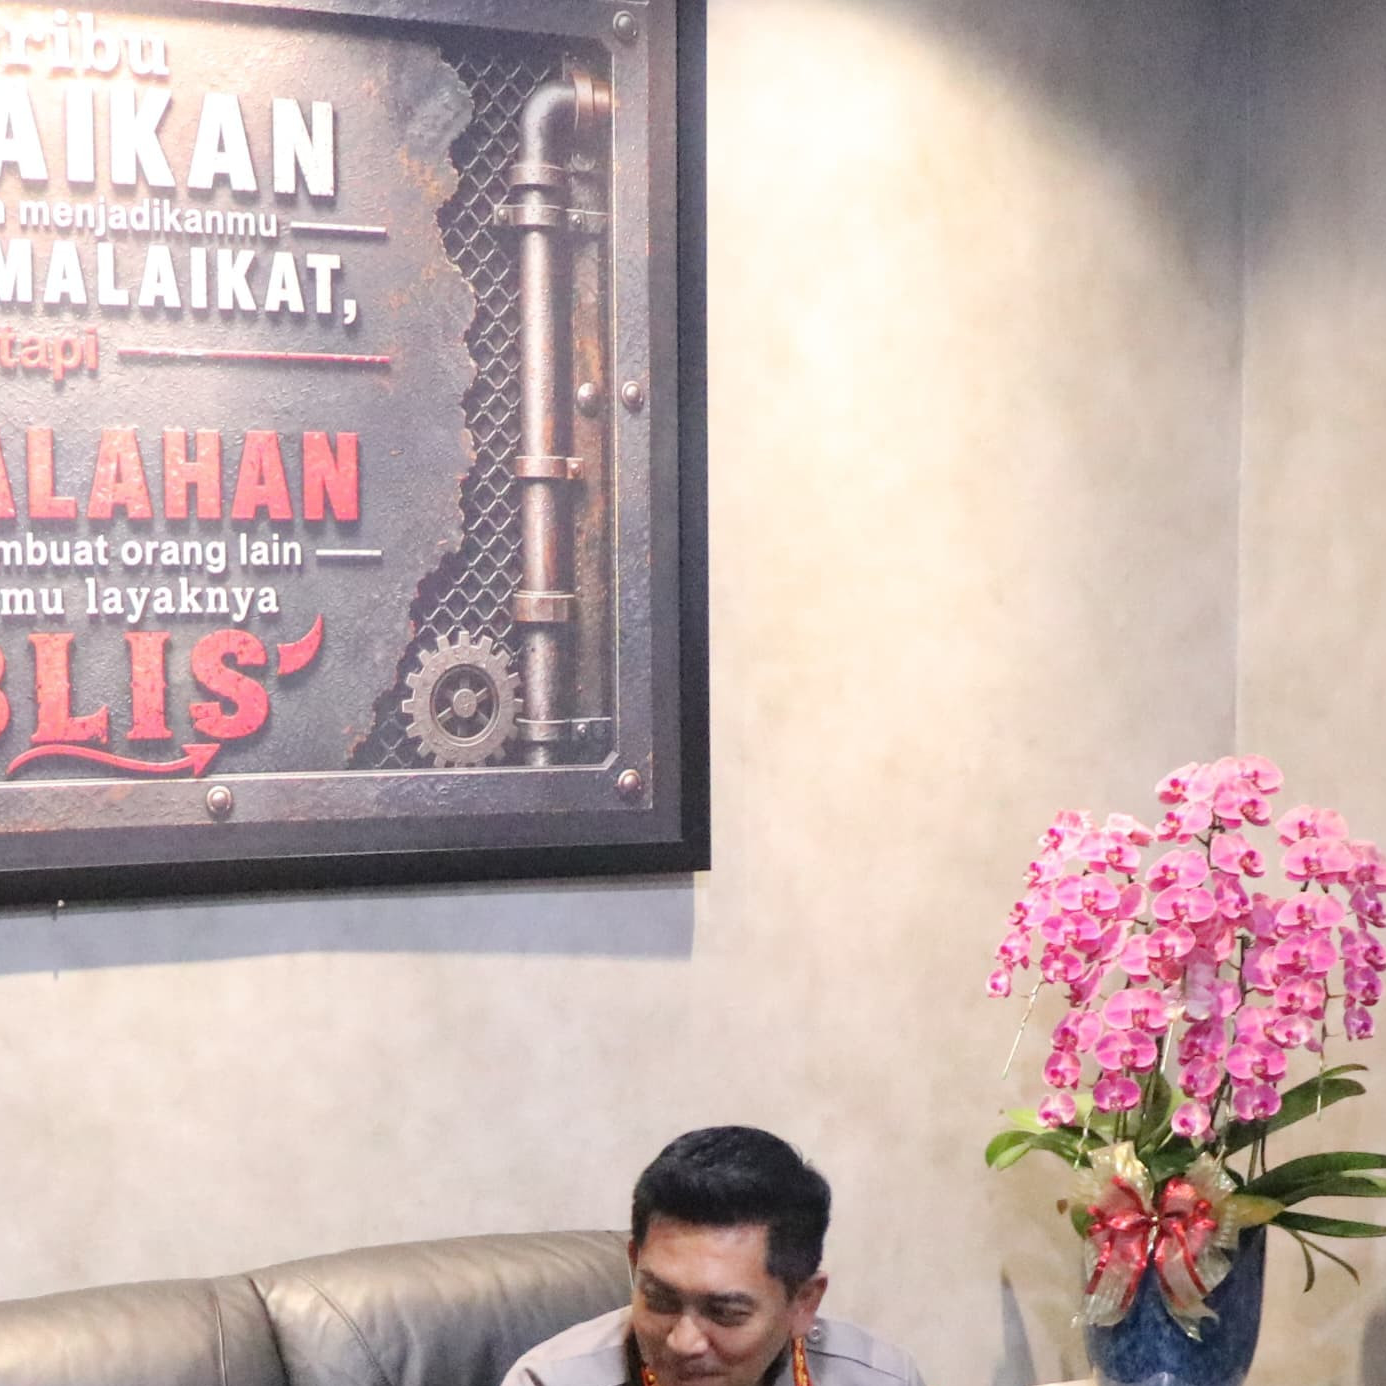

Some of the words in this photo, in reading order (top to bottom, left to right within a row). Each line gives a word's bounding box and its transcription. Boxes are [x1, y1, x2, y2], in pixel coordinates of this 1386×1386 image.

[20, 195, 279, 239] menjadikanmu
[120, 541, 228, 573] orang
[238, 534, 303, 566] lain
[85, 577, 280, 624] layaknya
